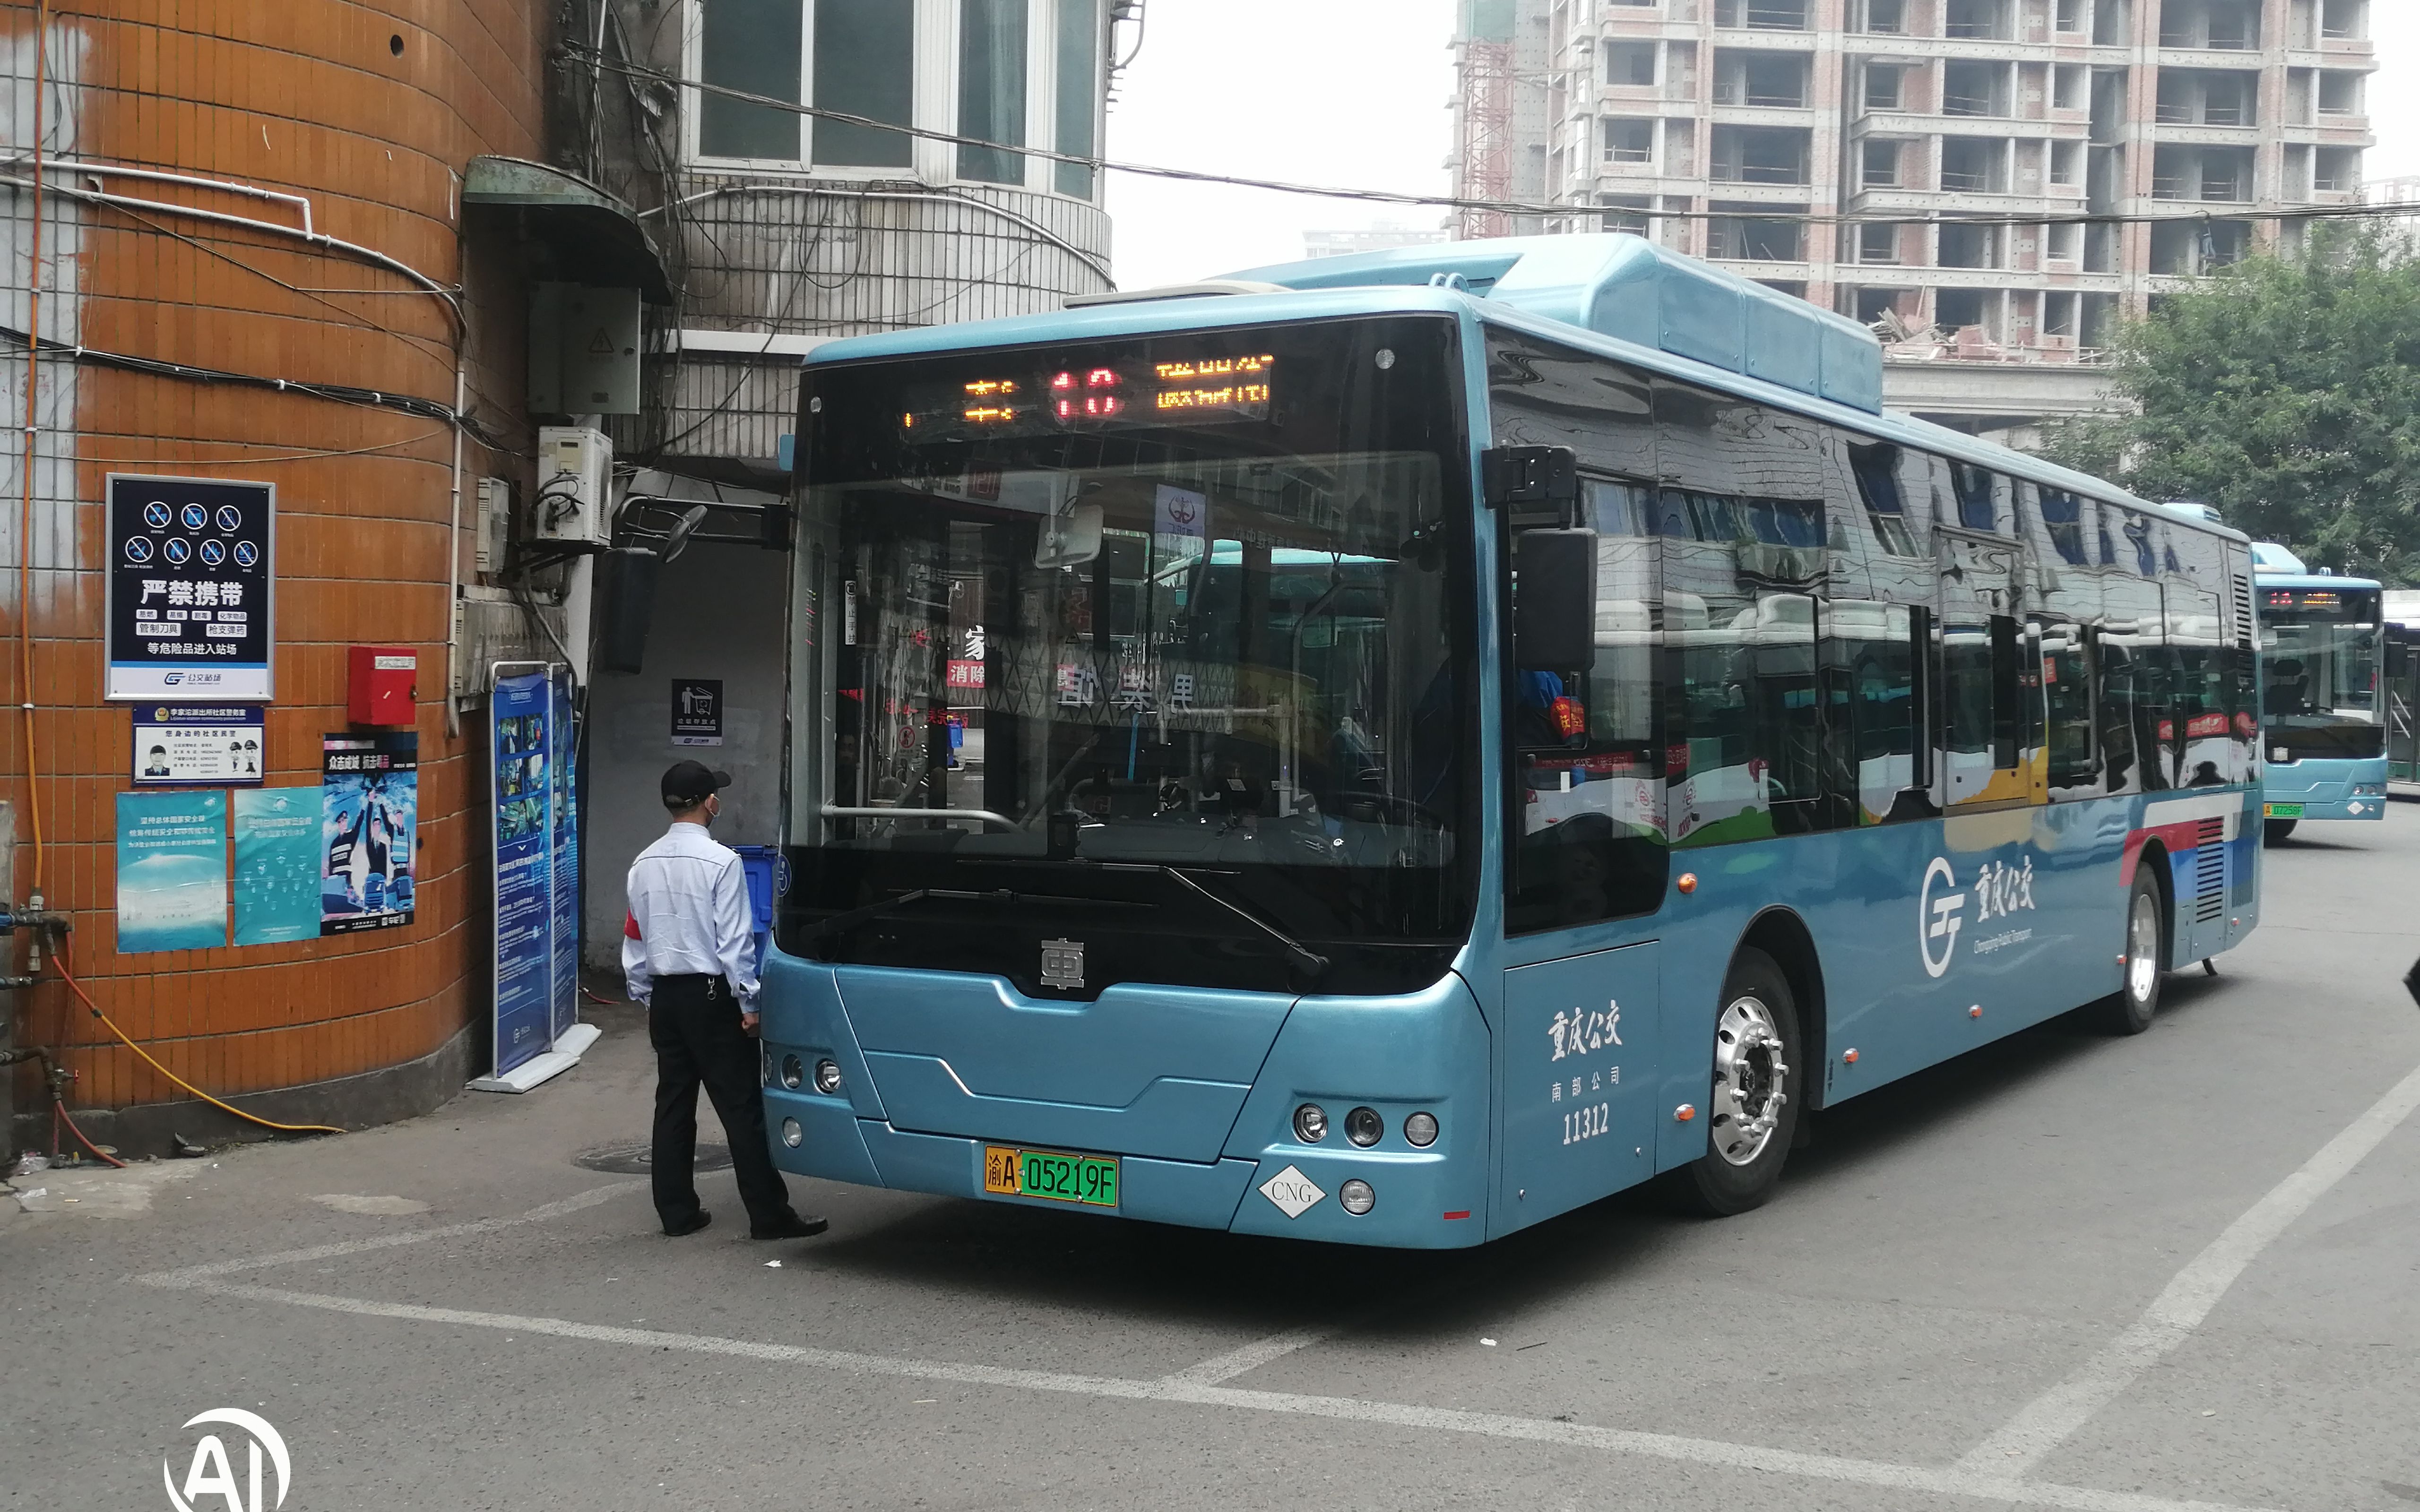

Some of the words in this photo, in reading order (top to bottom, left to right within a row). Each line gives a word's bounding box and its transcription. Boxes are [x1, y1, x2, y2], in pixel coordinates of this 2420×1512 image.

[141, 580, 242, 606] 严禁携带
[140, 624, 178, 633] 管制刀具
[209, 625, 245, 635] 枪支弹药
[147, 642, 237, 655] 等危险品进入站场
[1975, 855, 2035, 923] 重庆公交
[1548, 999, 1622, 1061] 重庆公交
[1552, 1066, 1619, 1103] 南部公司
[1564, 1102, 1608, 1145] 11312
[1272, 1181, 1312, 1203] CNG
